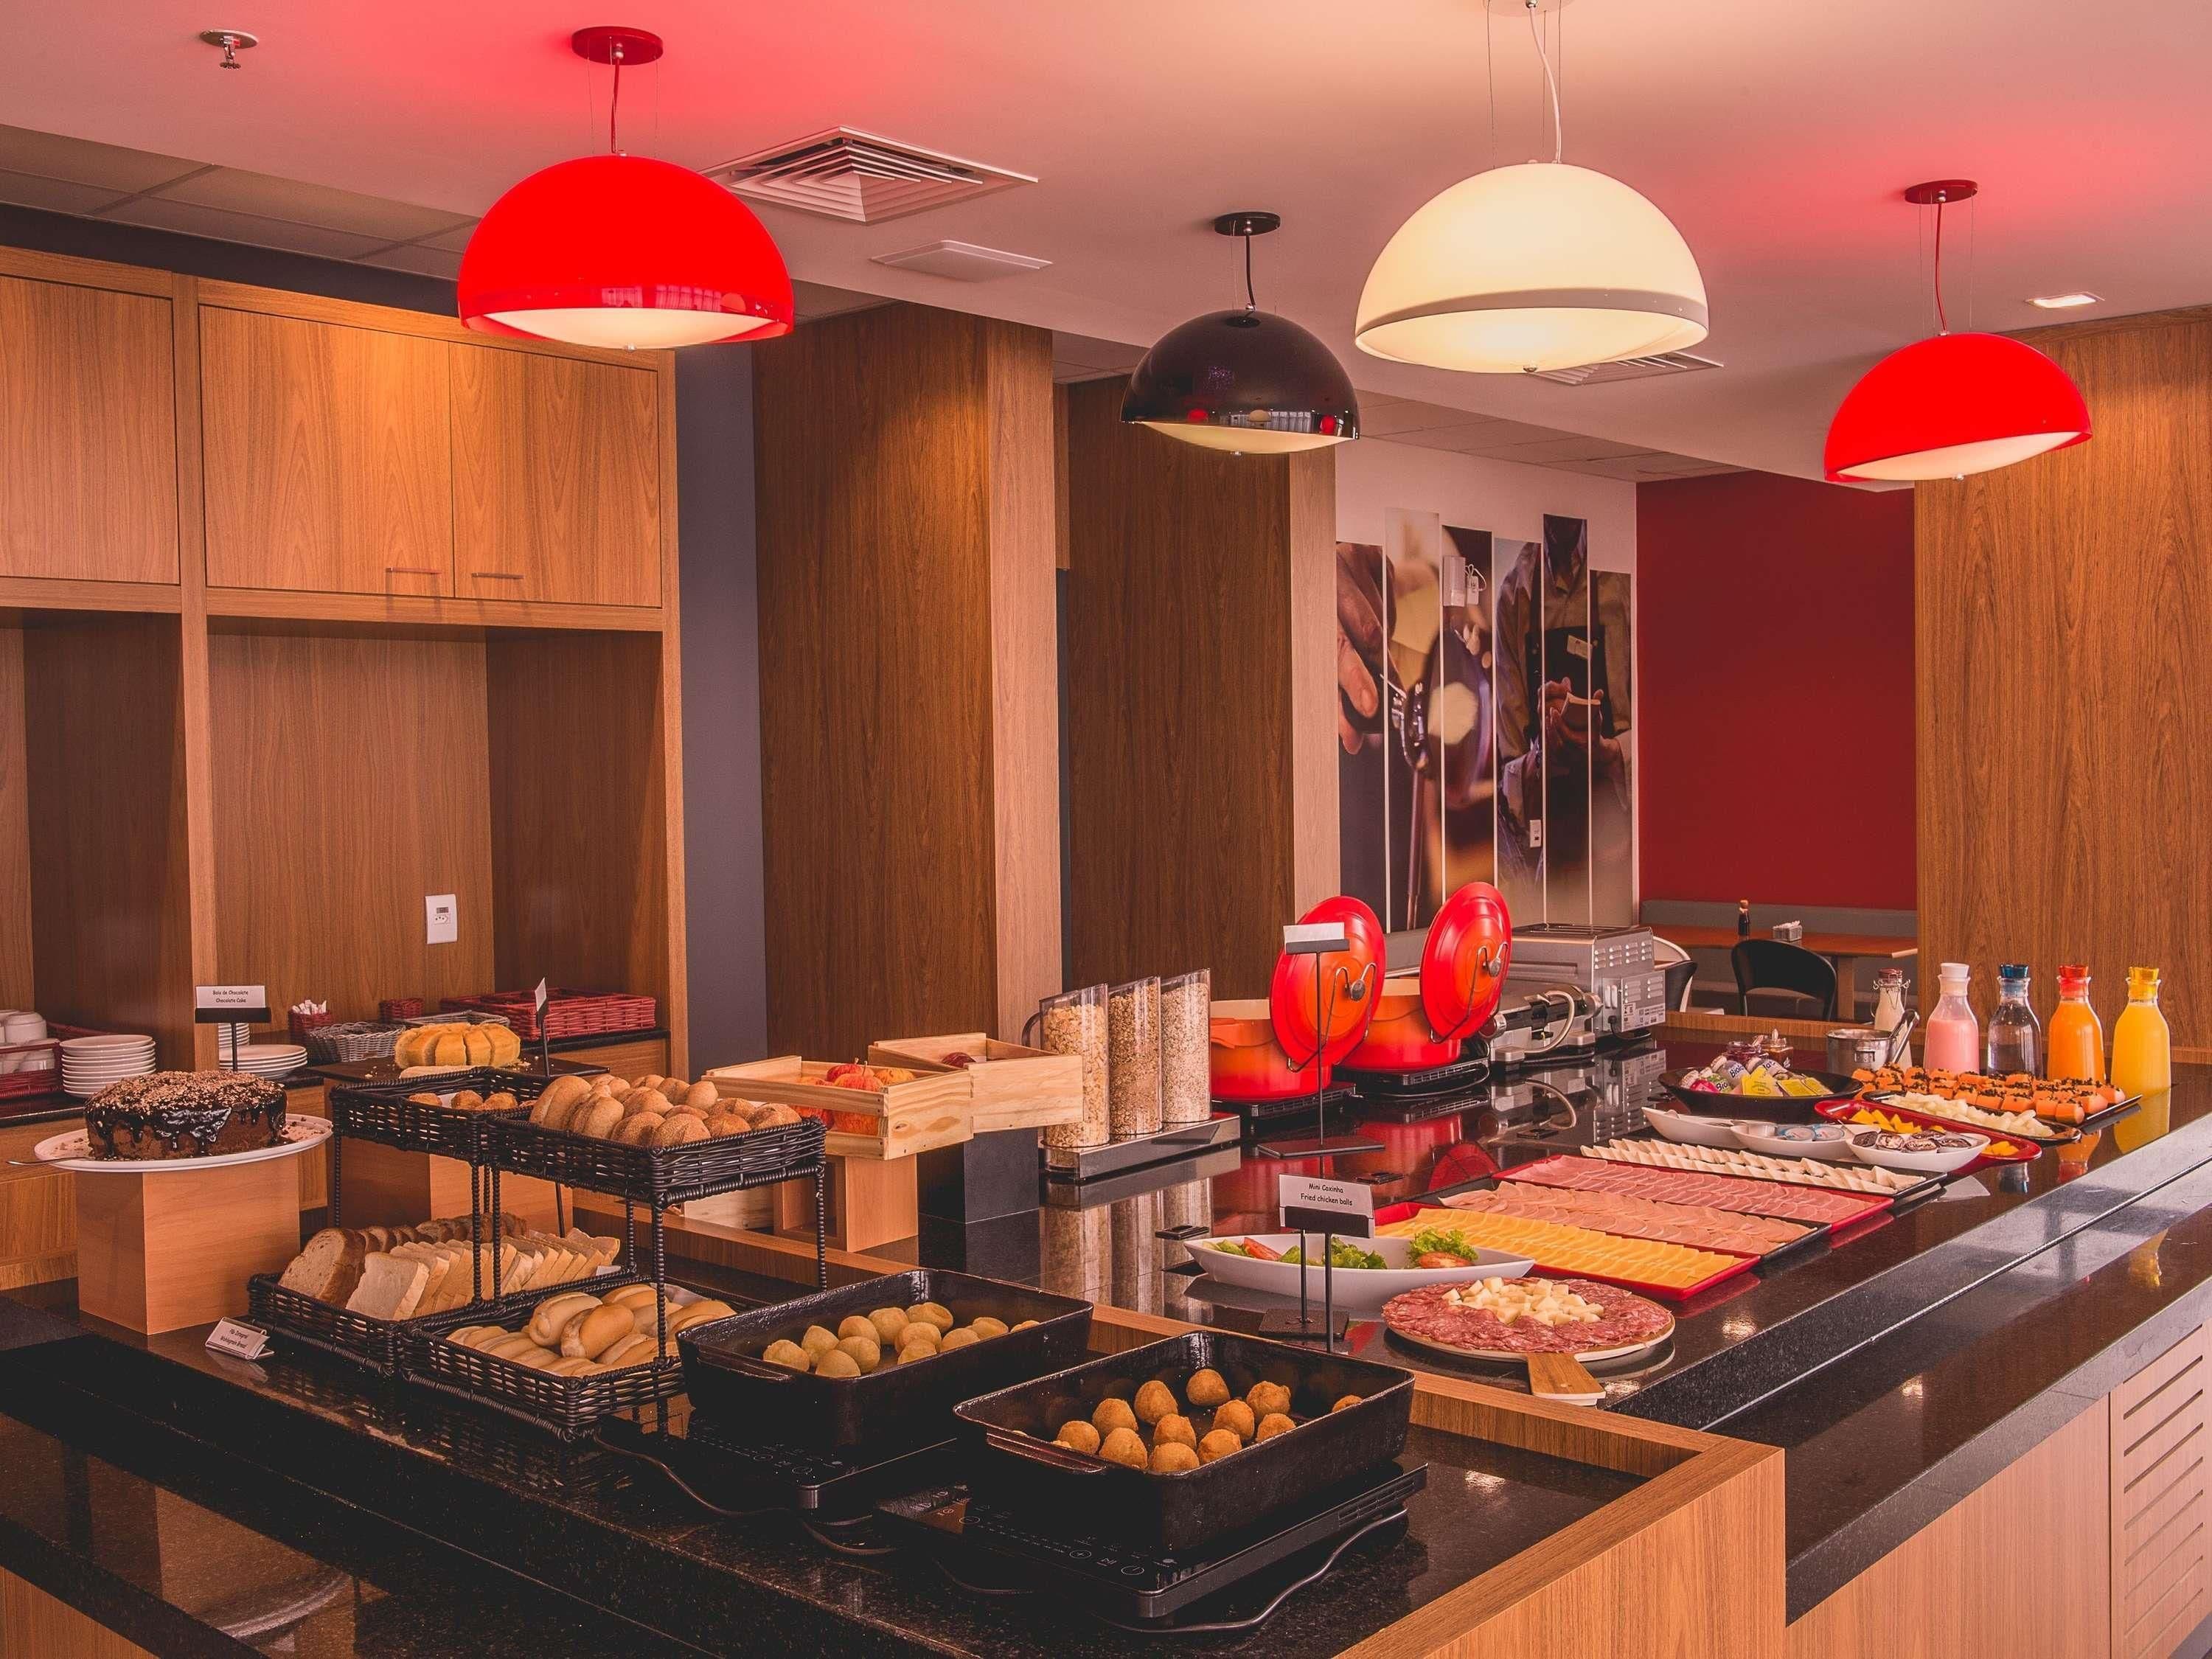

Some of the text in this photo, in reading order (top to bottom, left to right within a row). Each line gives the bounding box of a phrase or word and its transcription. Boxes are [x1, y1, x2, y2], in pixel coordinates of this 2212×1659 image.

[1321, 1184, 1343, 1193] Coxinha
[1301, 1192, 1353, 1206] Fried chicken balls
